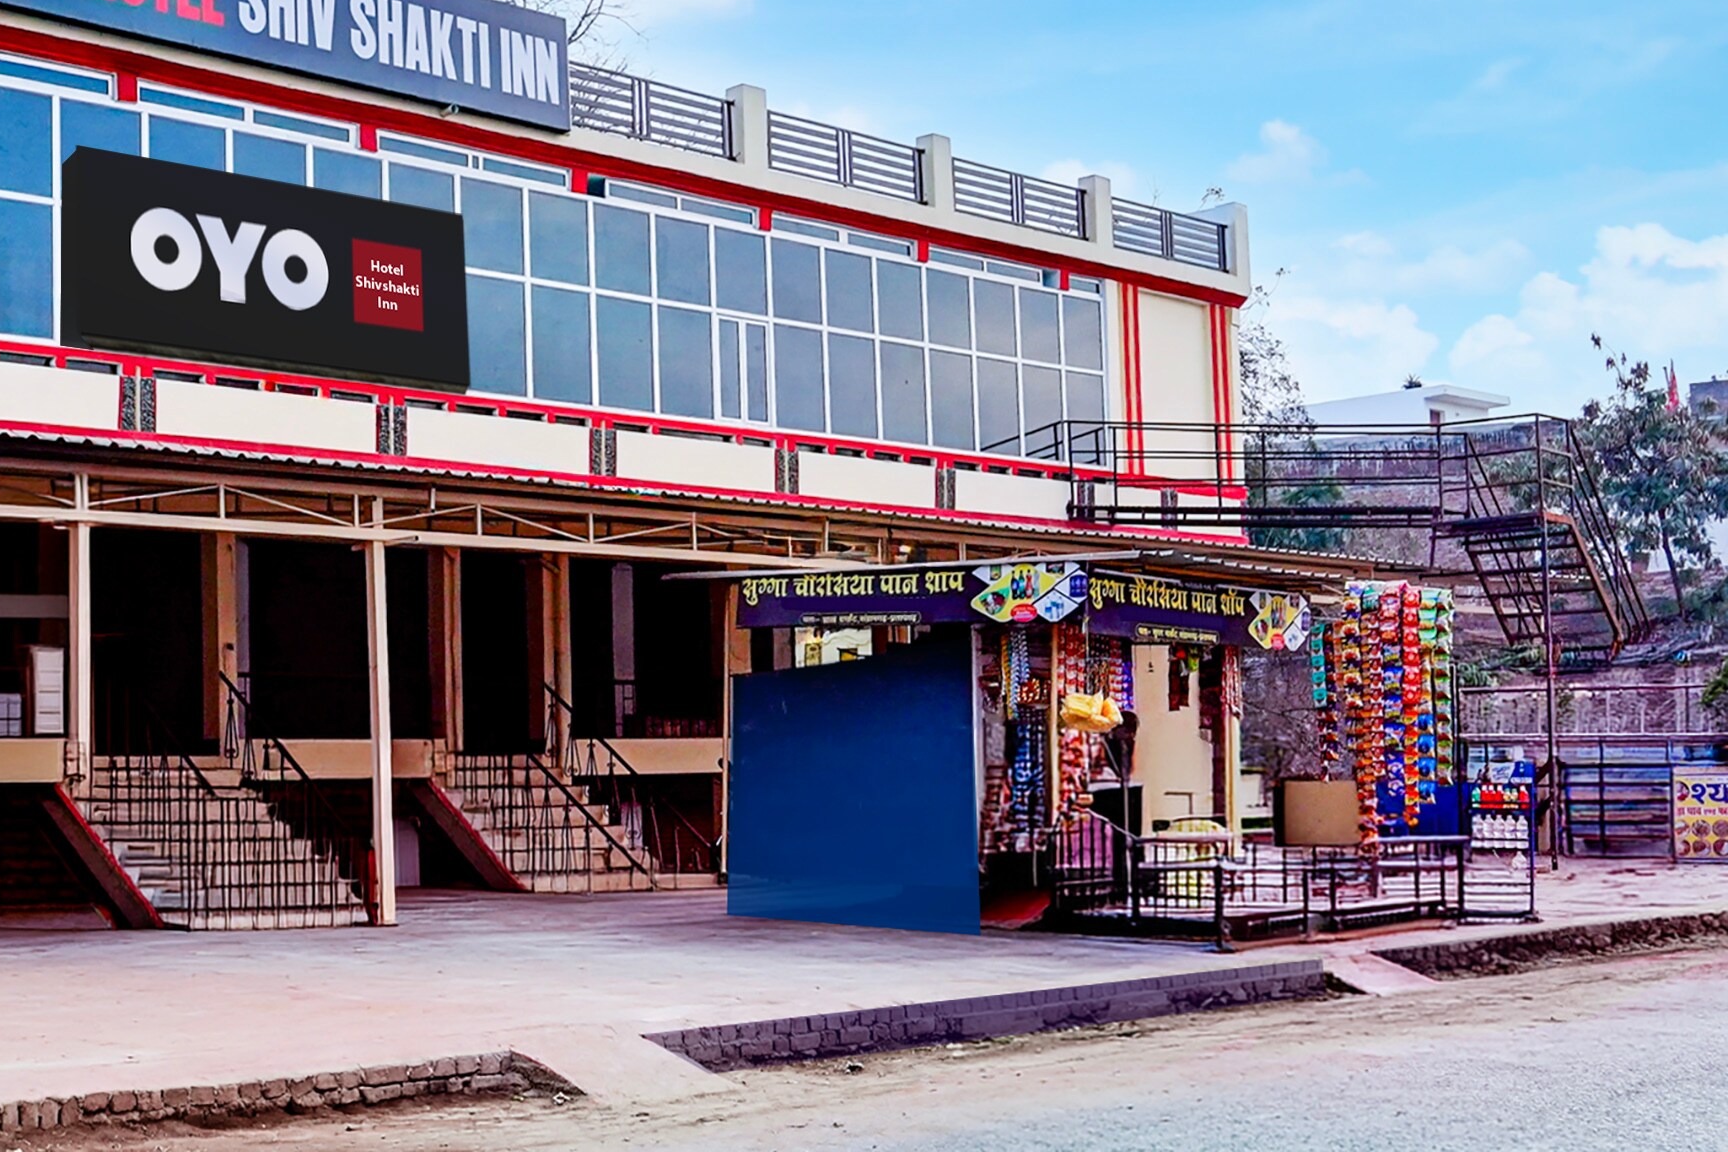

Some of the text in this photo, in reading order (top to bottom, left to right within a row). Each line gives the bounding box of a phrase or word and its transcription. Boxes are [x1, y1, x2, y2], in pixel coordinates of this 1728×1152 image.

[500, 30, 561, 106] INN
[130, 206, 329, 312] OYO
[370, 259, 404, 276] Hotel
[355, 275, 420, 296] Shivshakti
[377, 296, 398, 311] Inn
[880, 573, 920, 595] पान
[1191, 591, 1217, 614] पान
